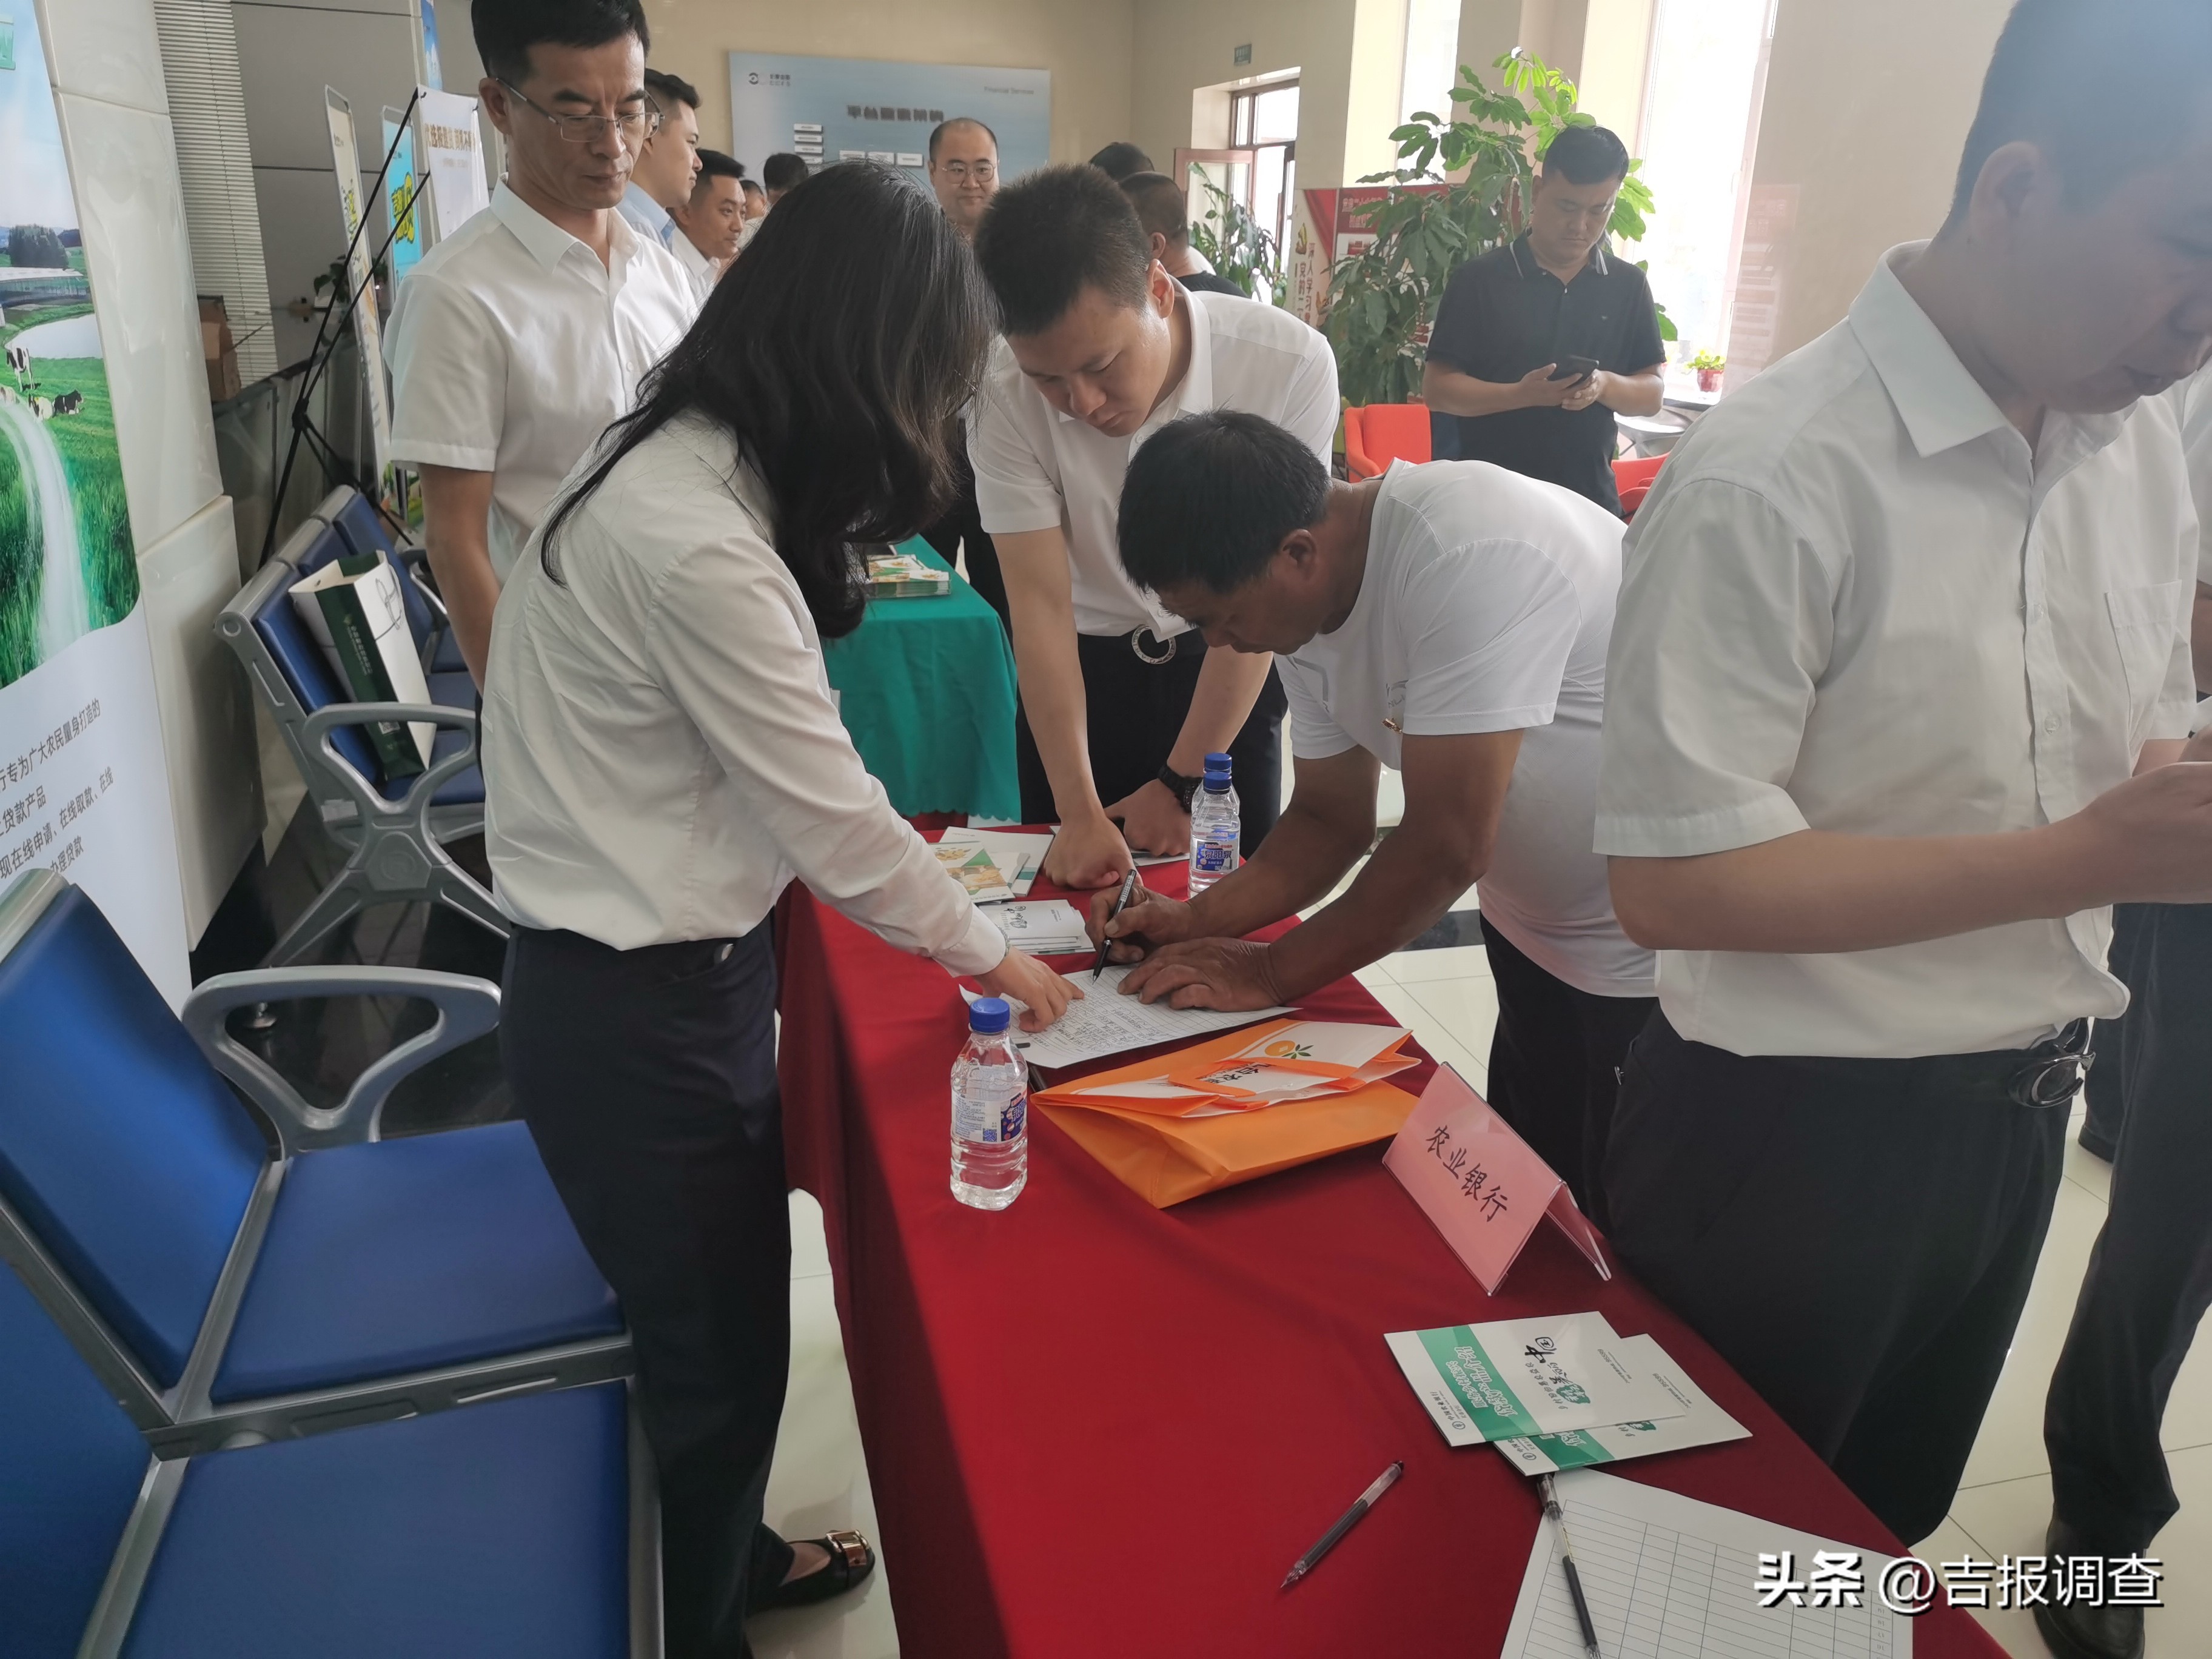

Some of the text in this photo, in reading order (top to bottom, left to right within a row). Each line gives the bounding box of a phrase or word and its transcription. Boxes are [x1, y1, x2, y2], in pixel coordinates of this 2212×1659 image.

[1426, 1125, 1509, 1222] 农业银行
[1446, 1361, 1489, 1408] 服务乡村振兴
[1454, 1346, 1518, 1416] 贷款产品介绍
